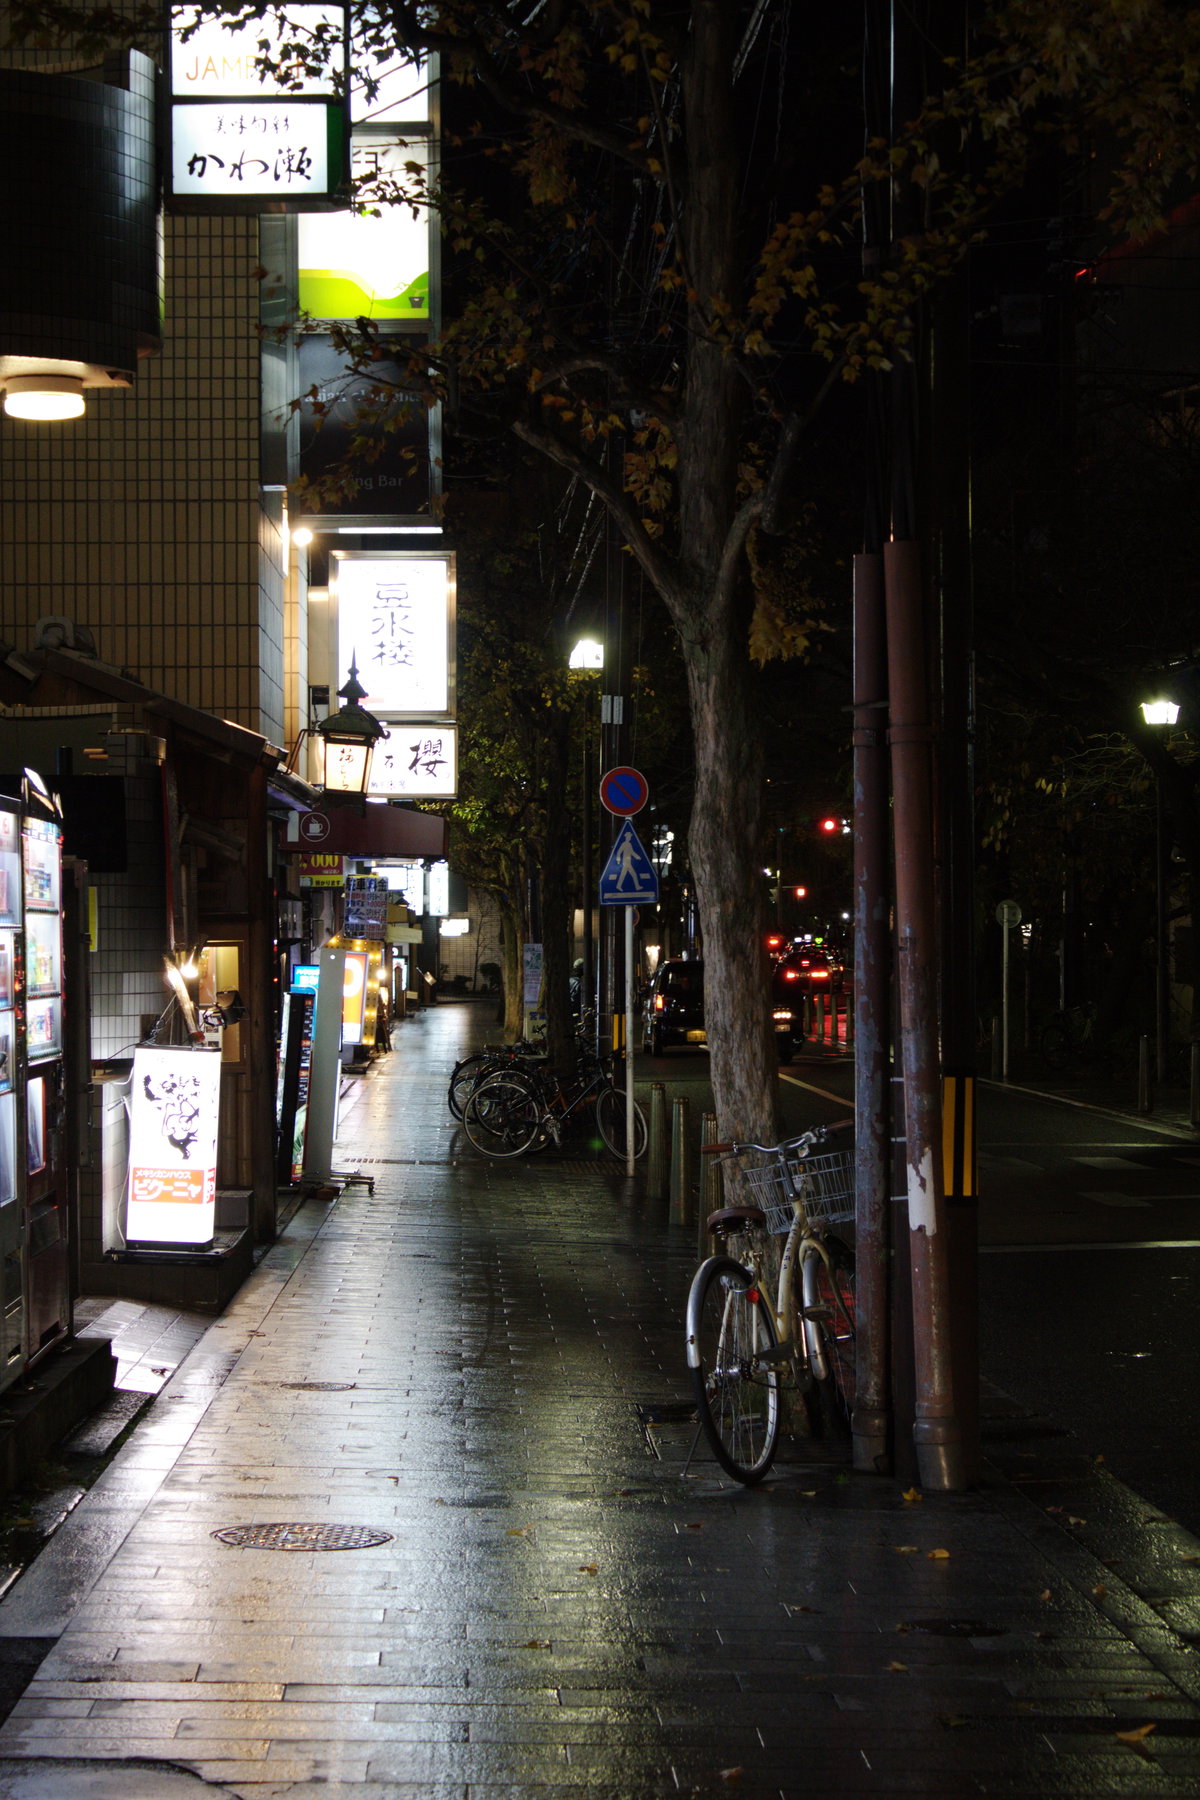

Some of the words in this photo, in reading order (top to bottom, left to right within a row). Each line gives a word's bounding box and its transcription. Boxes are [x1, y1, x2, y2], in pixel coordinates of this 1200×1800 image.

[187, 147, 313, 183] かわ瀬
[378, 474, 404, 487] Bar
[372, 582, 414, 666] 豆水楼
[135, 1170, 192, 1180] メキシカンハウス
[133, 1179, 202, 1201] ビクーニャ
